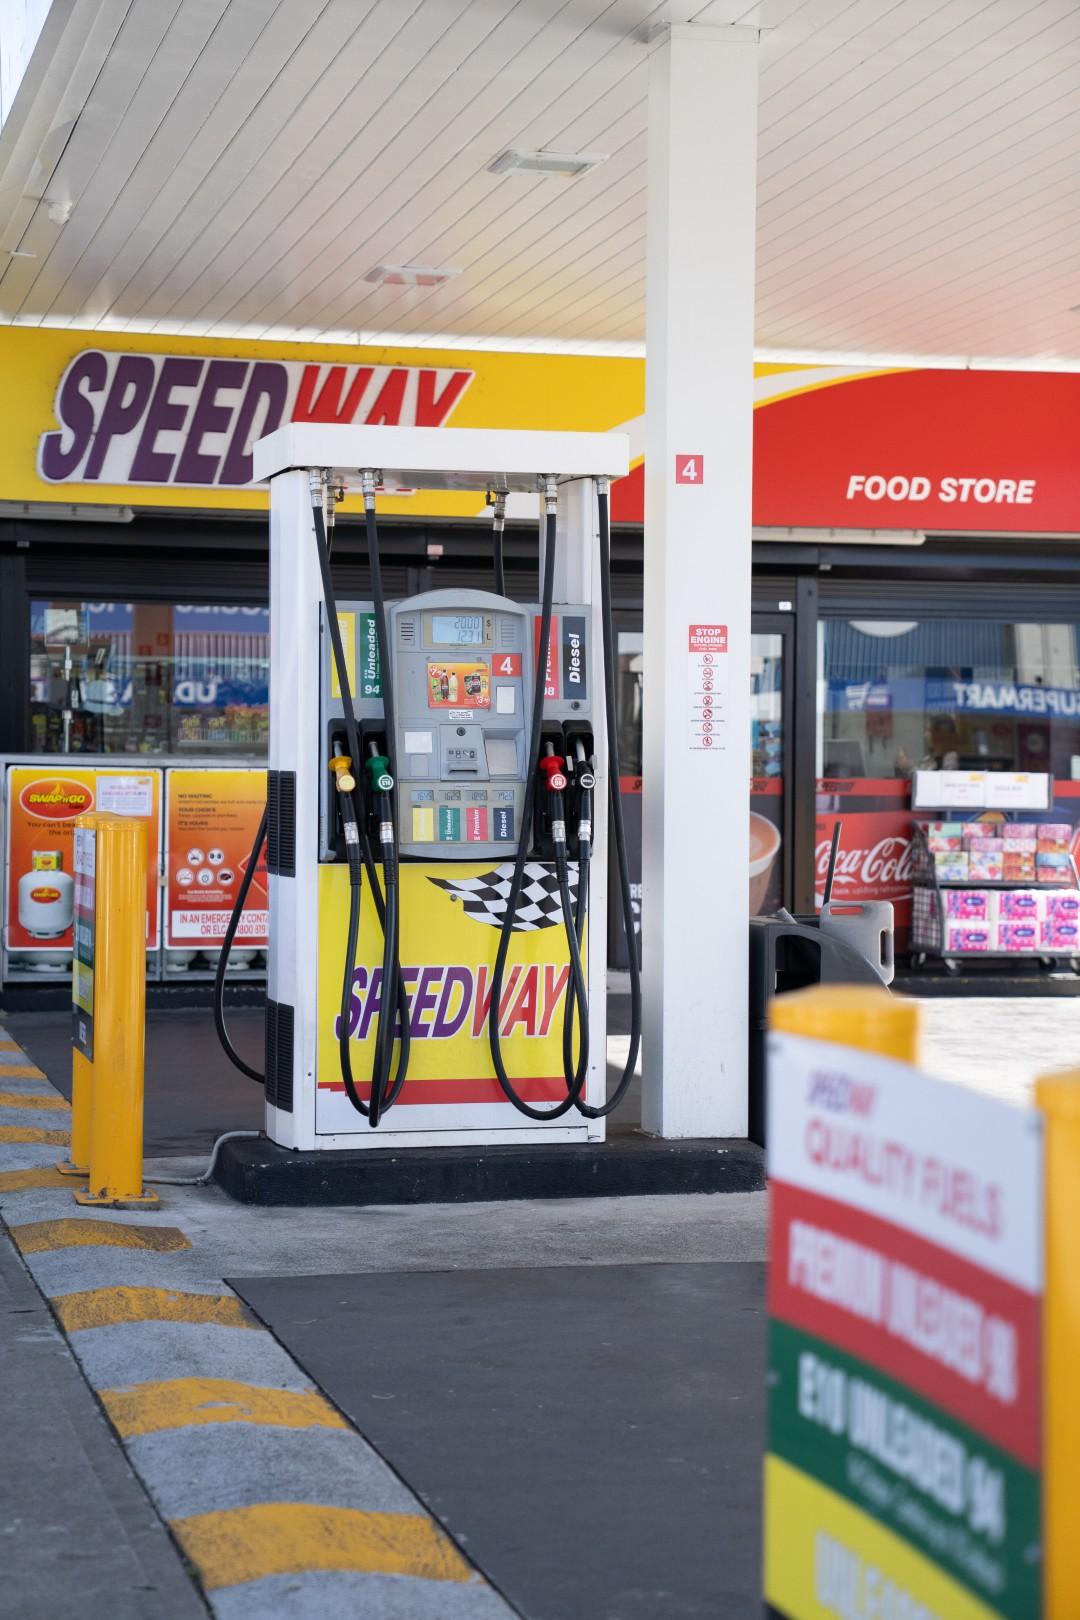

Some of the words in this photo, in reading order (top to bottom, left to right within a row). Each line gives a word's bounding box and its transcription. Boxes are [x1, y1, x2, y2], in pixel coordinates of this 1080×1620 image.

[682, 459, 698, 480] 4
[847, 475, 930, 501] FOOD
[938, 478, 1036, 504] STORE
[690, 636, 726, 644] ENGINE
[695, 628, 721, 636] STOP
[367, 619, 376, 679] Unleaded
[568, 633, 580, 684] Diesel
[500, 656, 513, 675] 4
[364, 684, 380, 694] 94
[180, 914, 188, 924] IN
[189, 914, 200, 923] AN
[201, 913, 245, 924] EMERGEY
[200, 925, 211, 935] OR
[804, 1118, 915, 1197] QUALITY
[922, 1157, 1004, 1240] FUELS
